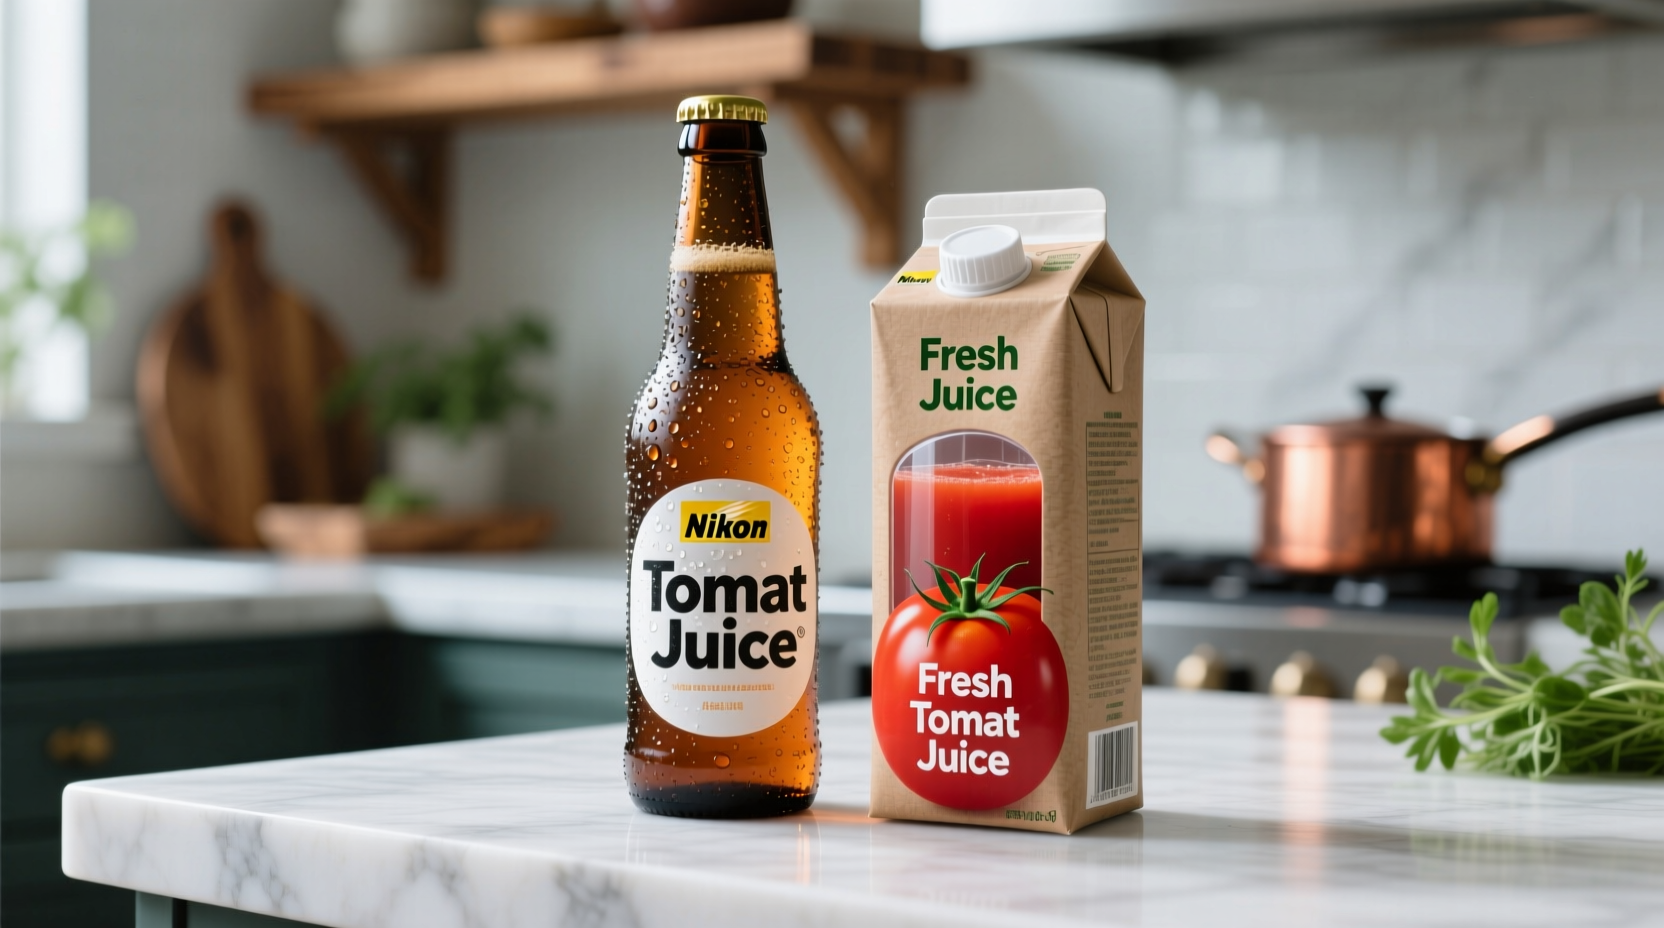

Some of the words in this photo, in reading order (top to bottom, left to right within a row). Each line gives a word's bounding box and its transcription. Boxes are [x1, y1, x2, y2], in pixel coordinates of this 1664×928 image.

[920, 335, 1018, 371] Fresh
[919, 376, 1018, 411] Juice
[684, 513, 768, 539] Nikon
[643, 560, 807, 614] Tomat
[651, 616, 797, 670] Juice
[918, 662, 1013, 698] Fresh
[909, 700, 1020, 738] Tomat
[916, 739, 1010, 776] Juice
